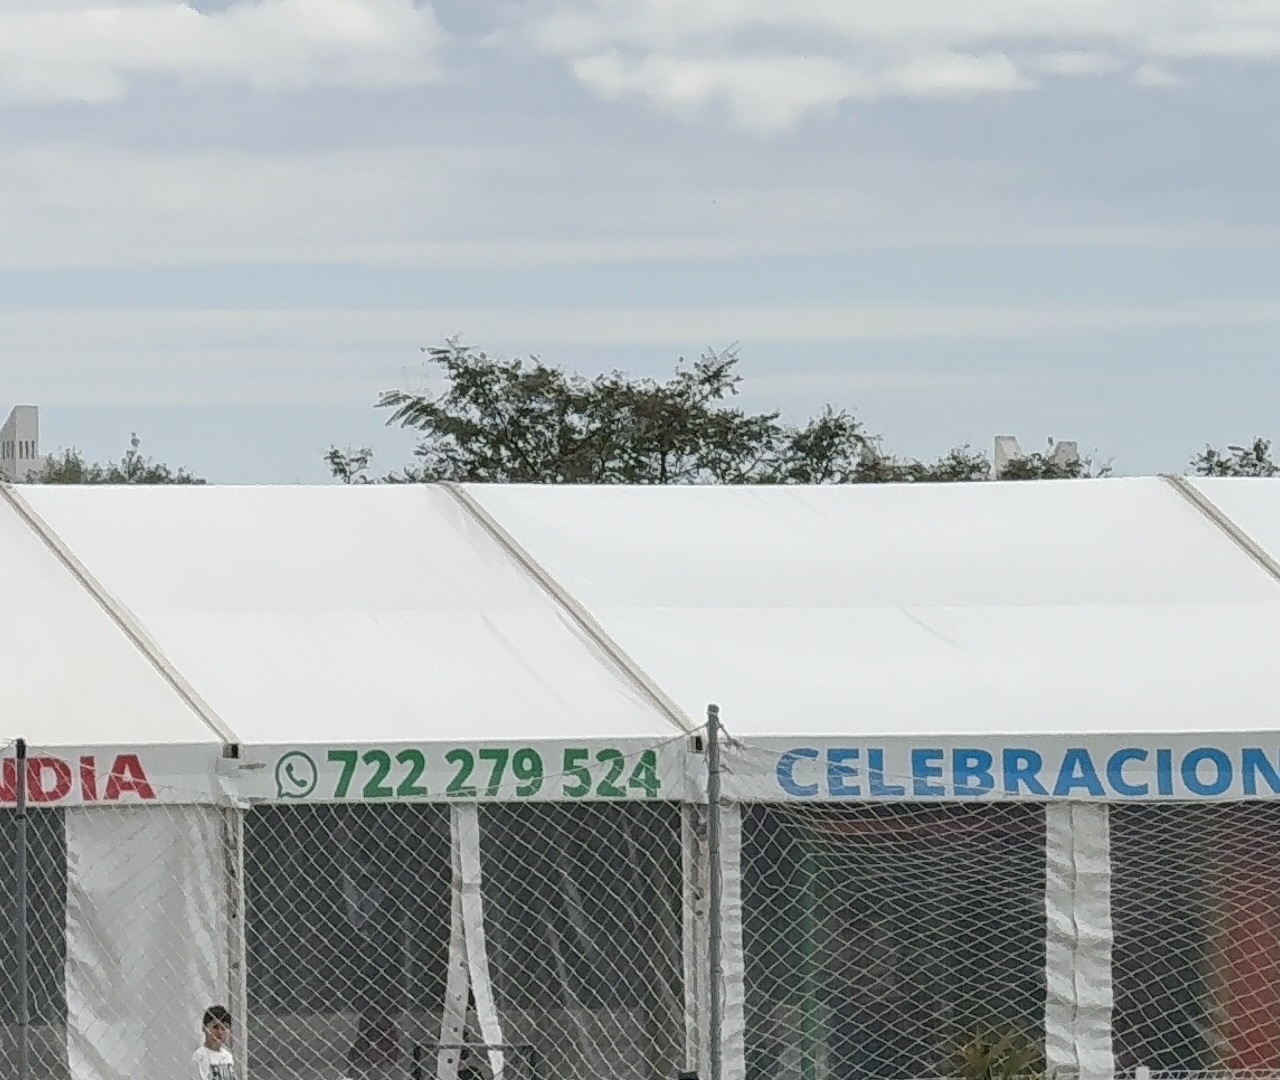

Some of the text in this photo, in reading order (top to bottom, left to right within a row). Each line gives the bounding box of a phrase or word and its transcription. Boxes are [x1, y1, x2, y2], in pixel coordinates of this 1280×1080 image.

[327, 748, 661, 798] 722 279 524
